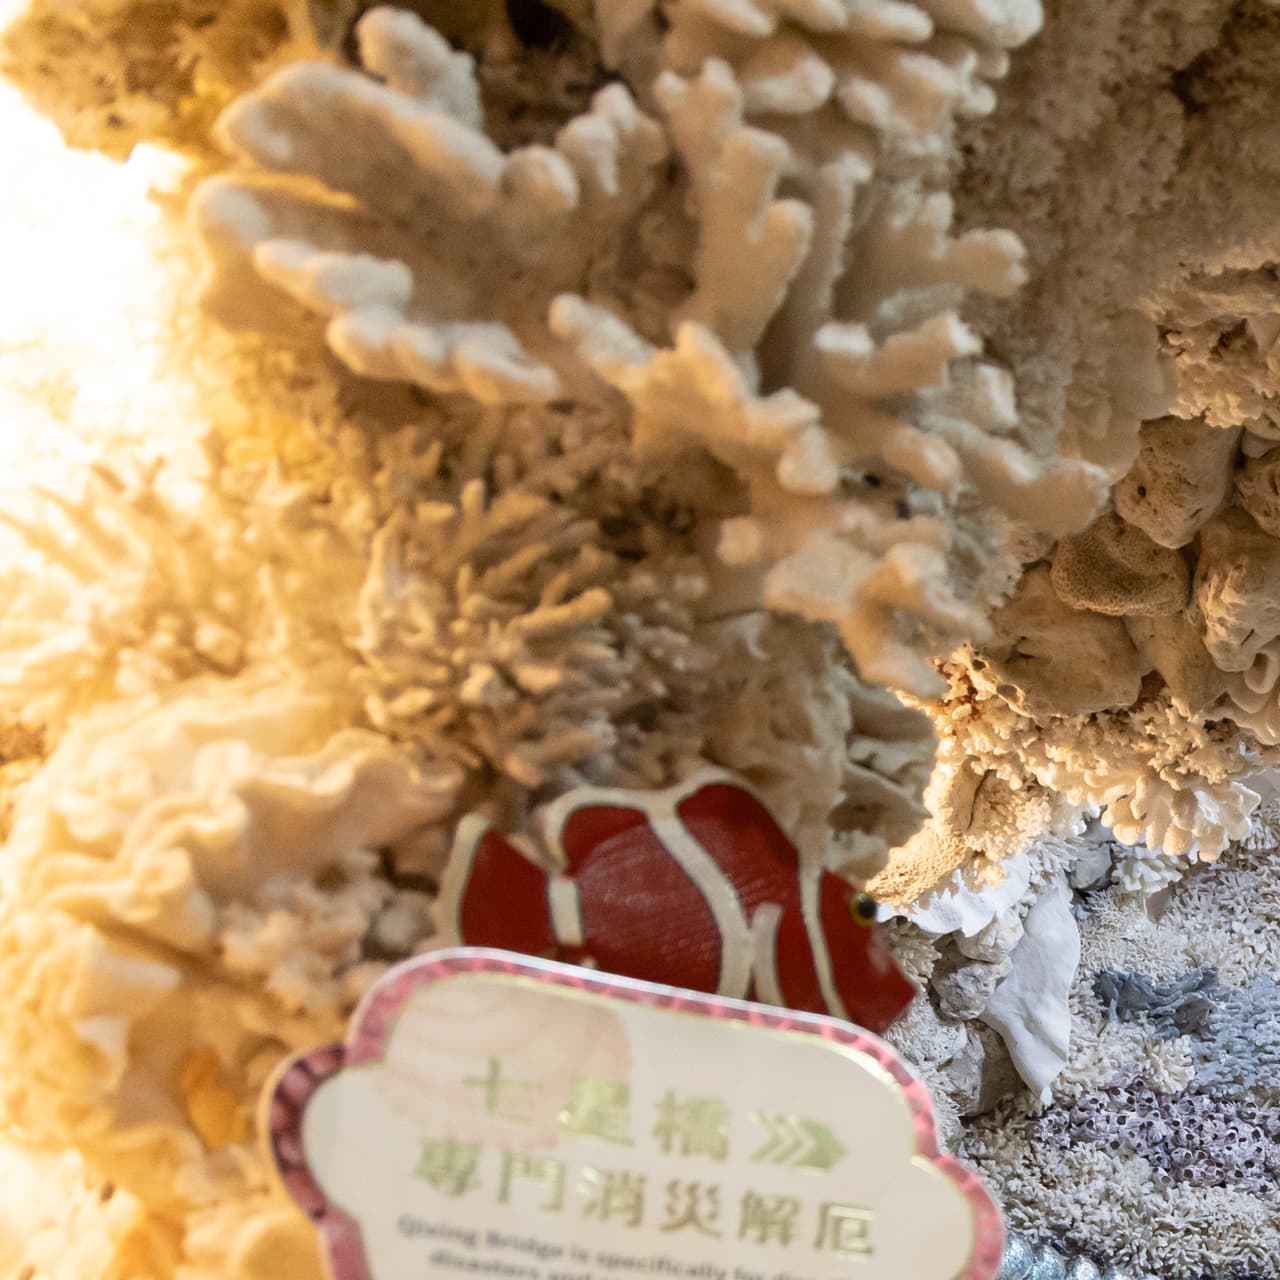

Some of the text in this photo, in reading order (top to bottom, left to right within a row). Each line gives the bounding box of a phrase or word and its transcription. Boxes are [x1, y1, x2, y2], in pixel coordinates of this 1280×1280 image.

[461, 1056, 728, 1162] 七星橋
[412, 1135, 875, 1259] 專門消災解厄
[398, 1214, 477, 1248] Qixing
[485, 1230, 564, 1260] Bridge
[570, 1245, 589, 1263] is
[429, 1250, 540, 1280] disasters
